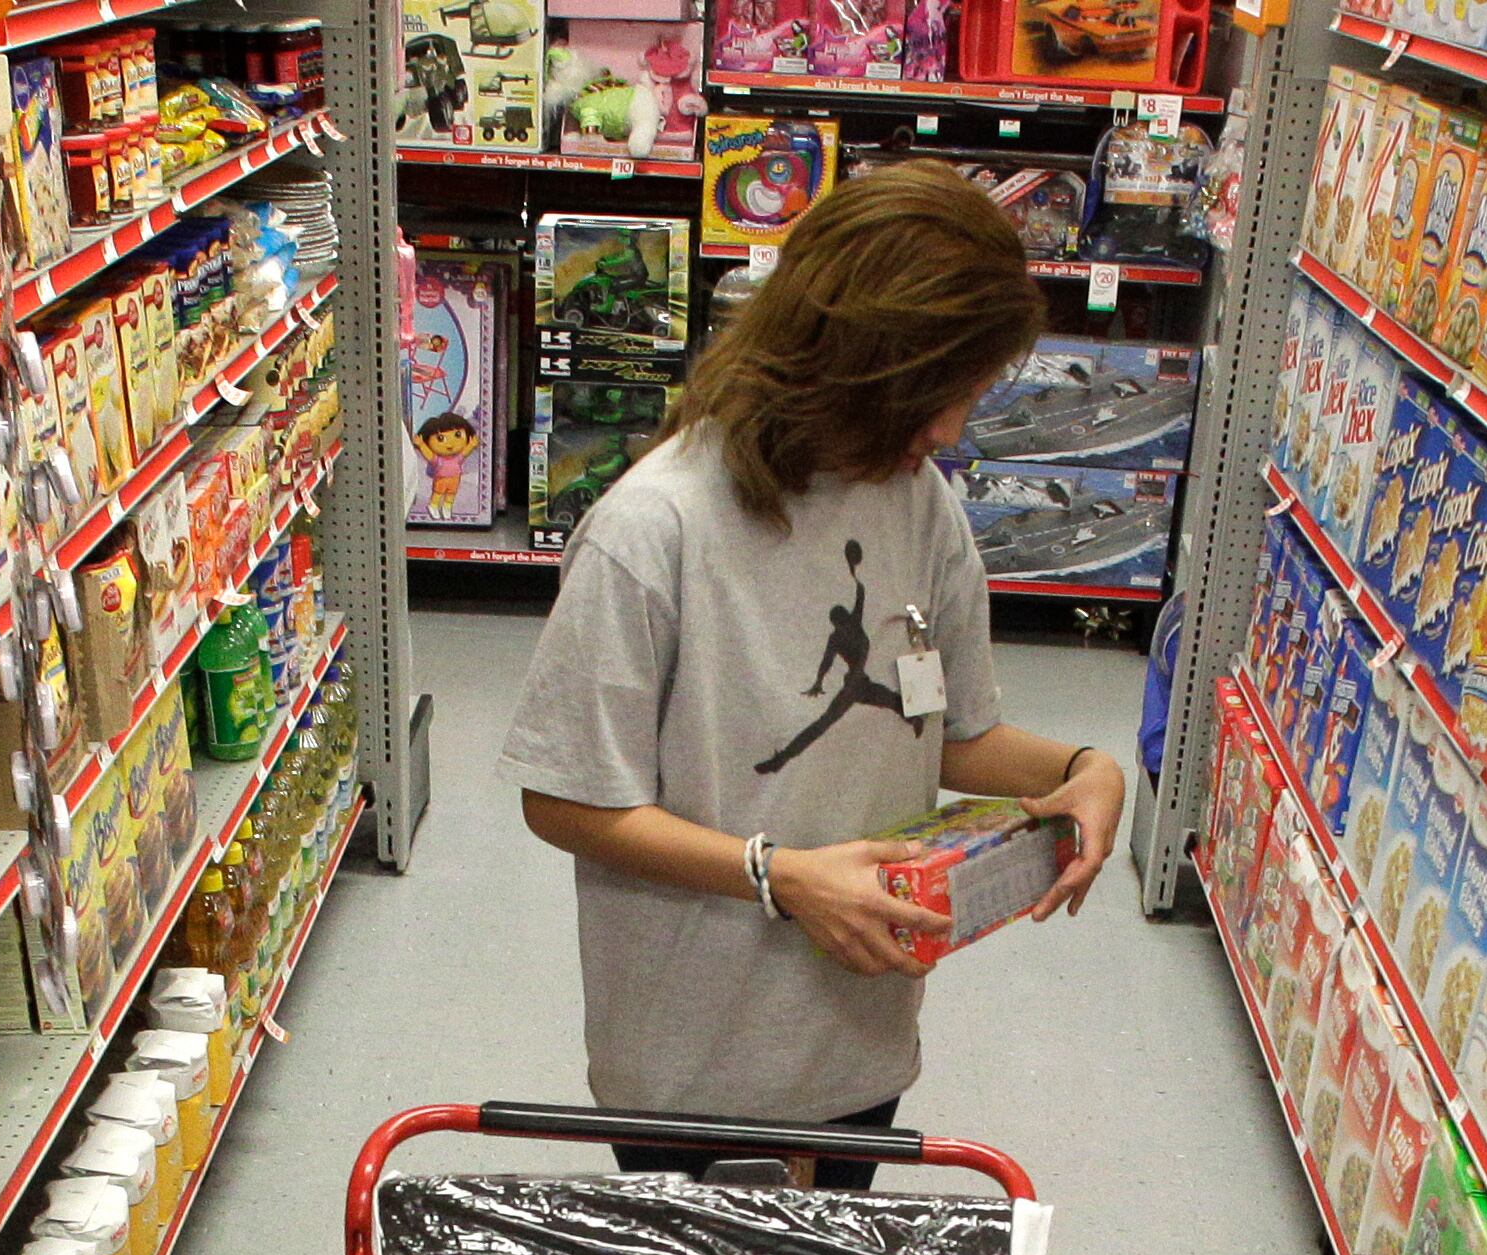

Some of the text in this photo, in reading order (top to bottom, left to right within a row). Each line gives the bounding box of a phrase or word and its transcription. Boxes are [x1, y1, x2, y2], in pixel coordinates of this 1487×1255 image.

[815, 79, 837, 91] don't
[840, 81, 864, 93] forget
[998, 89, 1023, 100] don't
[1025, 90, 1050, 102] forget
[481, 155, 502, 165] don't
[505, 157, 529, 168] forget
[531, 158, 545, 167] the
[547, 158, 561, 169] gift
